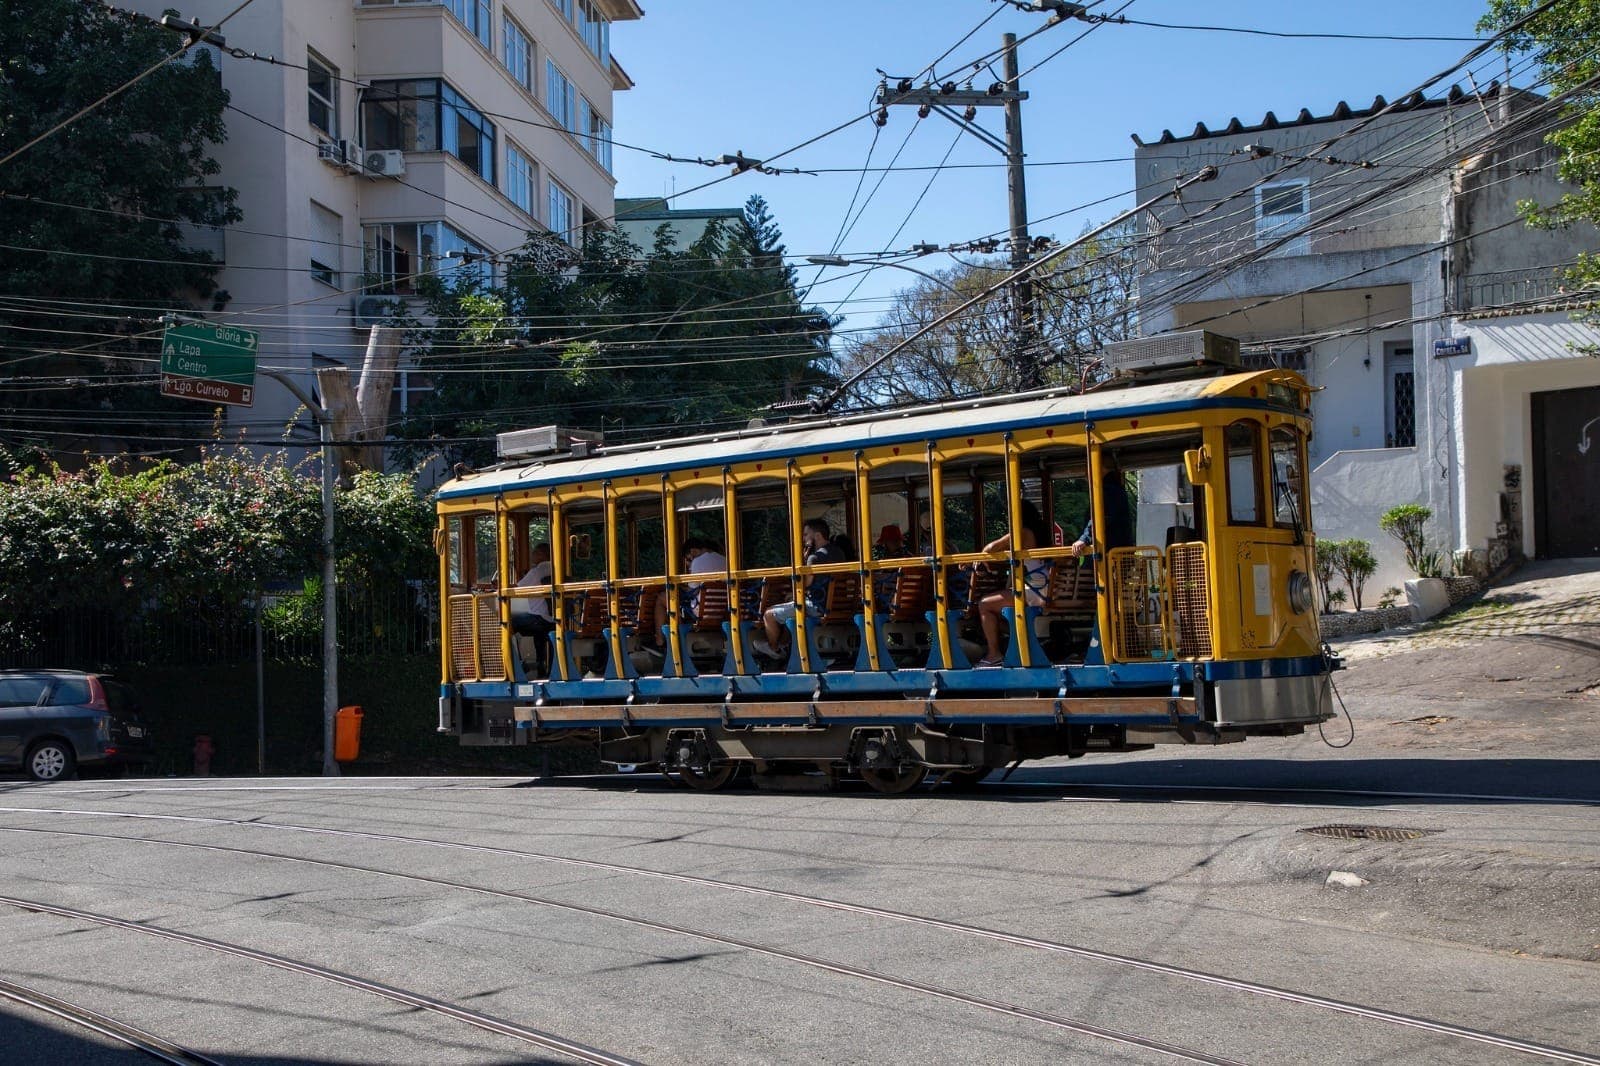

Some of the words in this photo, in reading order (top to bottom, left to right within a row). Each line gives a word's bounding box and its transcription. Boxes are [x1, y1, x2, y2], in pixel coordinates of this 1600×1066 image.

[215, 327, 241, 343] Glória
[179, 341, 201, 357] Lapa
[177, 358, 207, 373] Centro
[174, 380, 194, 394] Lgo.
[196, 382, 229, 398] Curvelo
